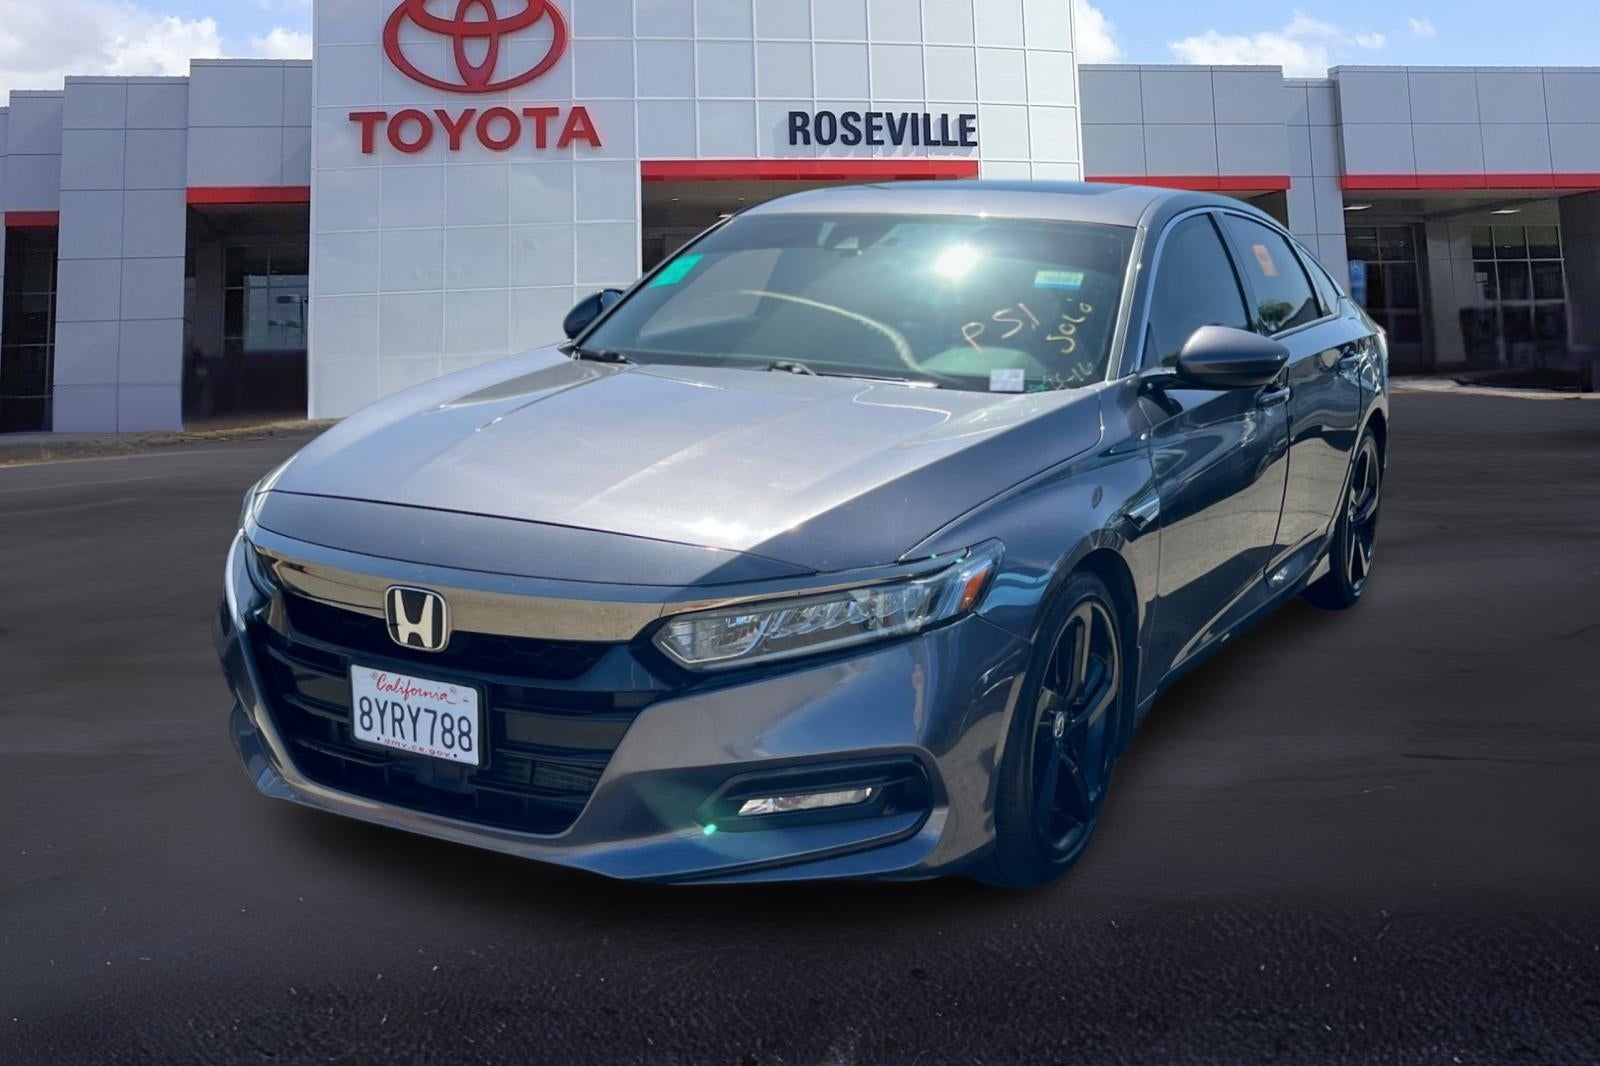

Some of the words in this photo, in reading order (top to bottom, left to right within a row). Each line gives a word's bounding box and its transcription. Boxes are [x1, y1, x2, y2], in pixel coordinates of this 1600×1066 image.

[349, 106, 602, 153] TOYOTA
[788, 111, 978, 147] ROSEVILLE
[376, 672, 456, 705] California
[359, 696, 473, 752] 8YRY788
[384, 738, 451, 758] dmv.ca.gov
